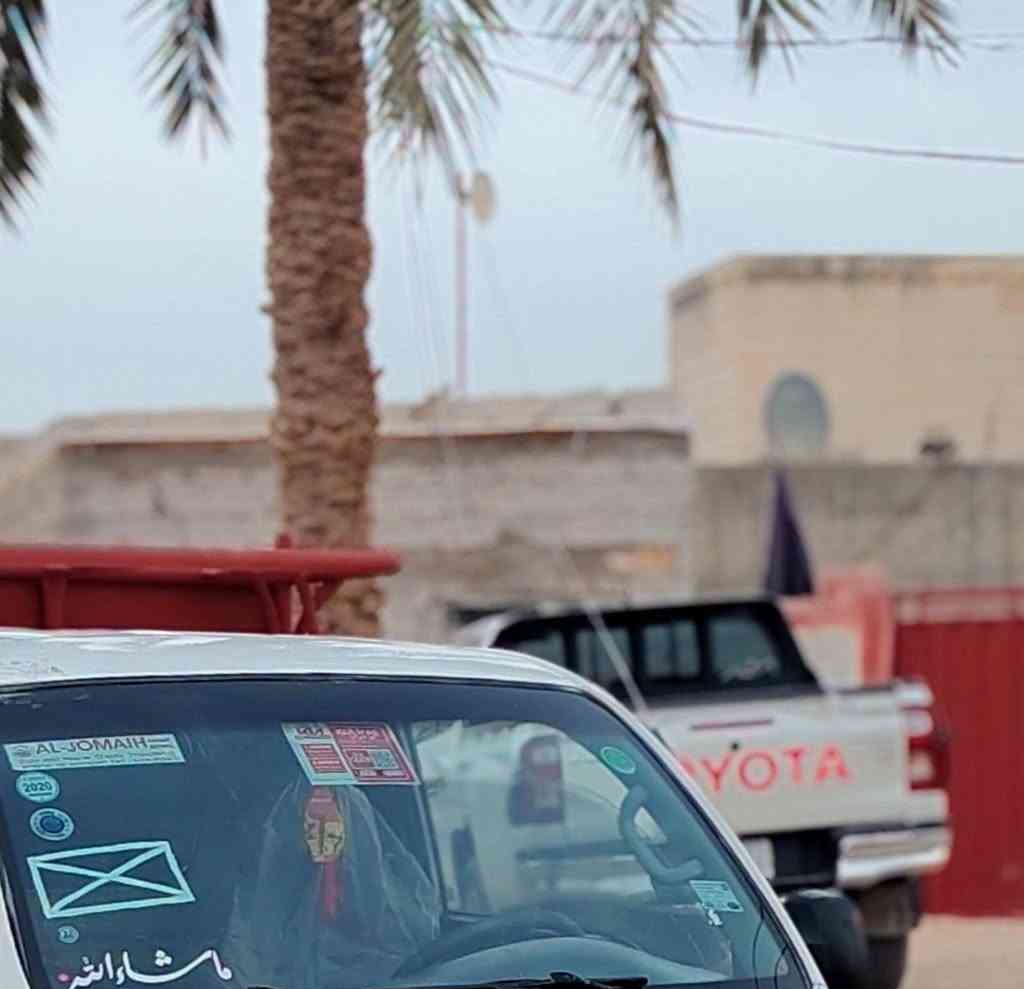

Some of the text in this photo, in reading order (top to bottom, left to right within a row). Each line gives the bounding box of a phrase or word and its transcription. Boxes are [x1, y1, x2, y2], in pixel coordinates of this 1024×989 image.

[36, 737, 148, 755] AL-JOMAIH
[680, 744, 852, 793] YOTA
[23, 781, 53, 793] 2020
